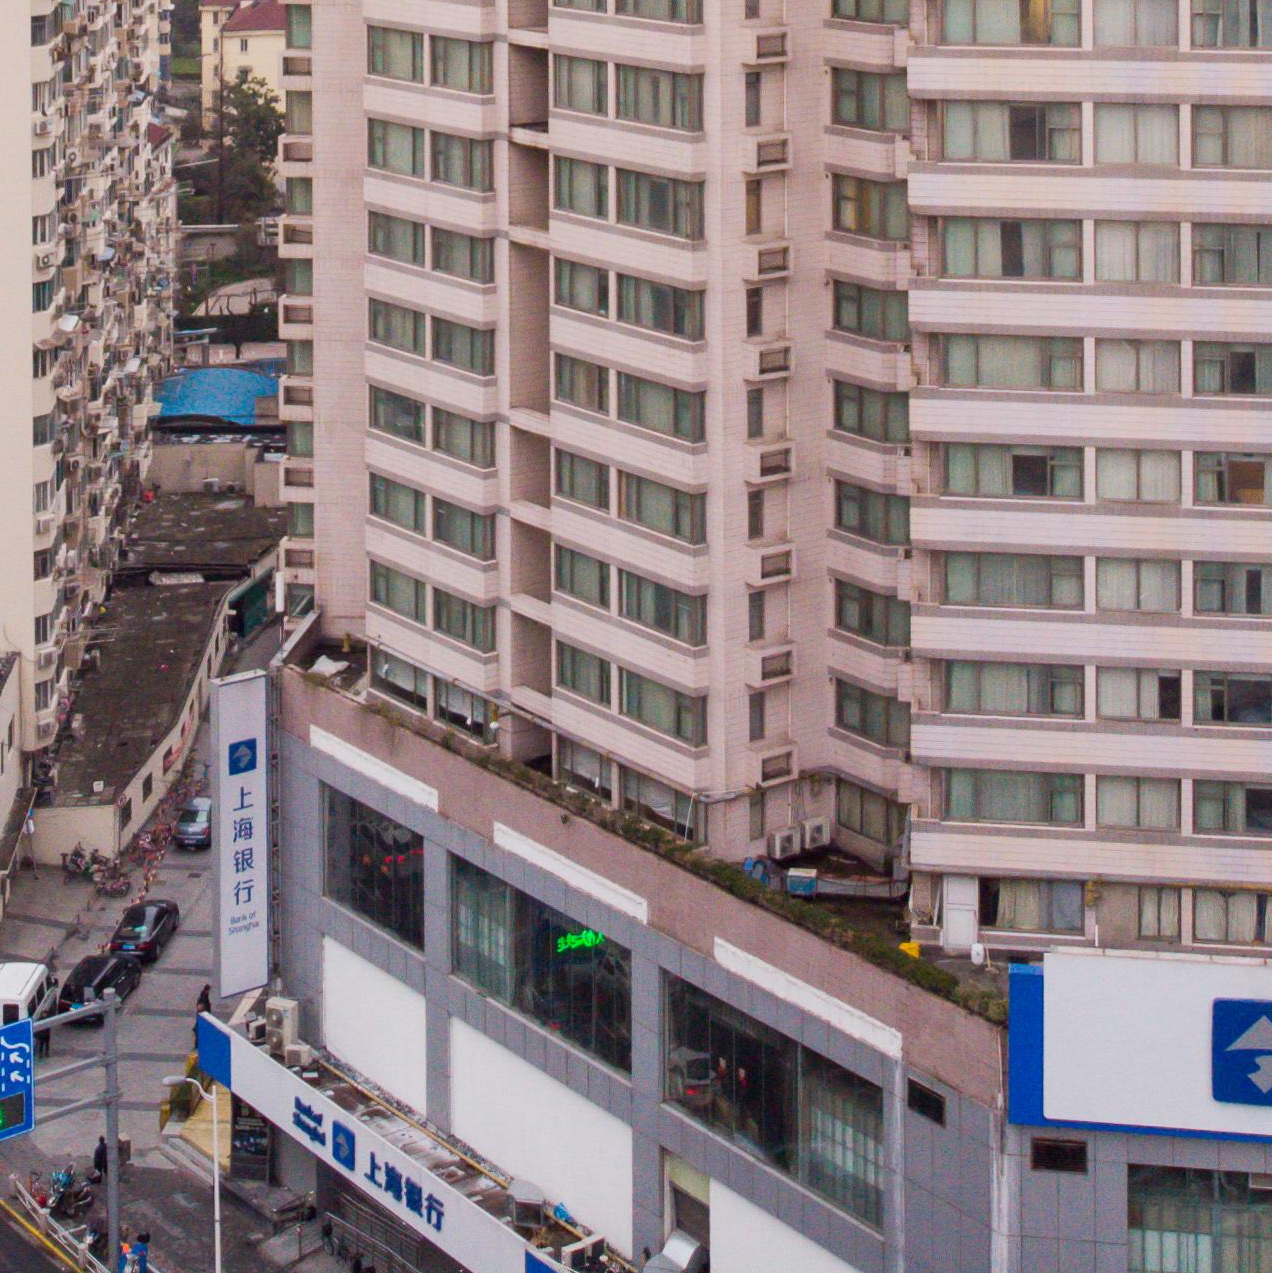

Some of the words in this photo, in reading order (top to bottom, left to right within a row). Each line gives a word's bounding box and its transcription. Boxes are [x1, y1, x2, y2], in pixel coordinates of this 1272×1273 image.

[233, 786, 255, 905] 上海银行
[364, 1151, 445, 1231] 上海银行
